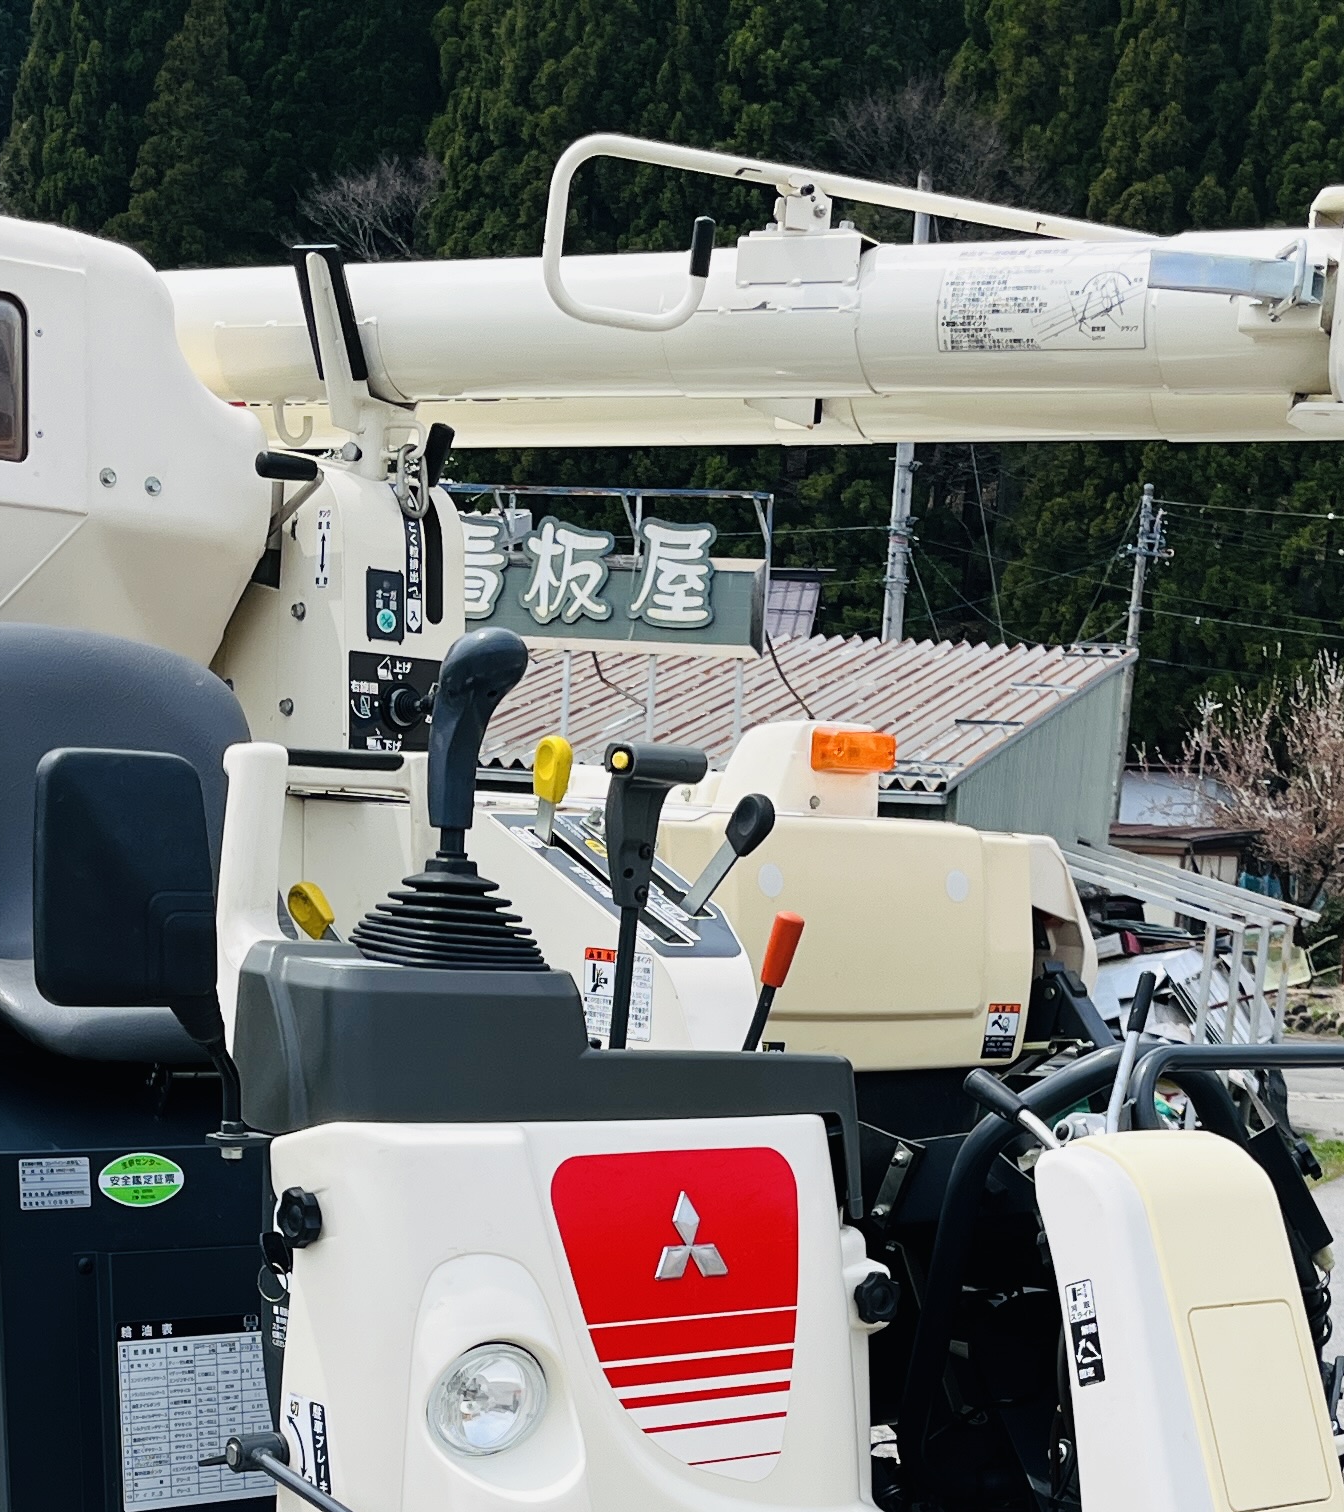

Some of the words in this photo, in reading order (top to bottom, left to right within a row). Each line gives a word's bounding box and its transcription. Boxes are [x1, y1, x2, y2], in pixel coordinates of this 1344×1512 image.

[109, 1173, 176, 1187] 安全鑑定証票
[311, 1403, 329, 1494] 駐車ブレーキ
